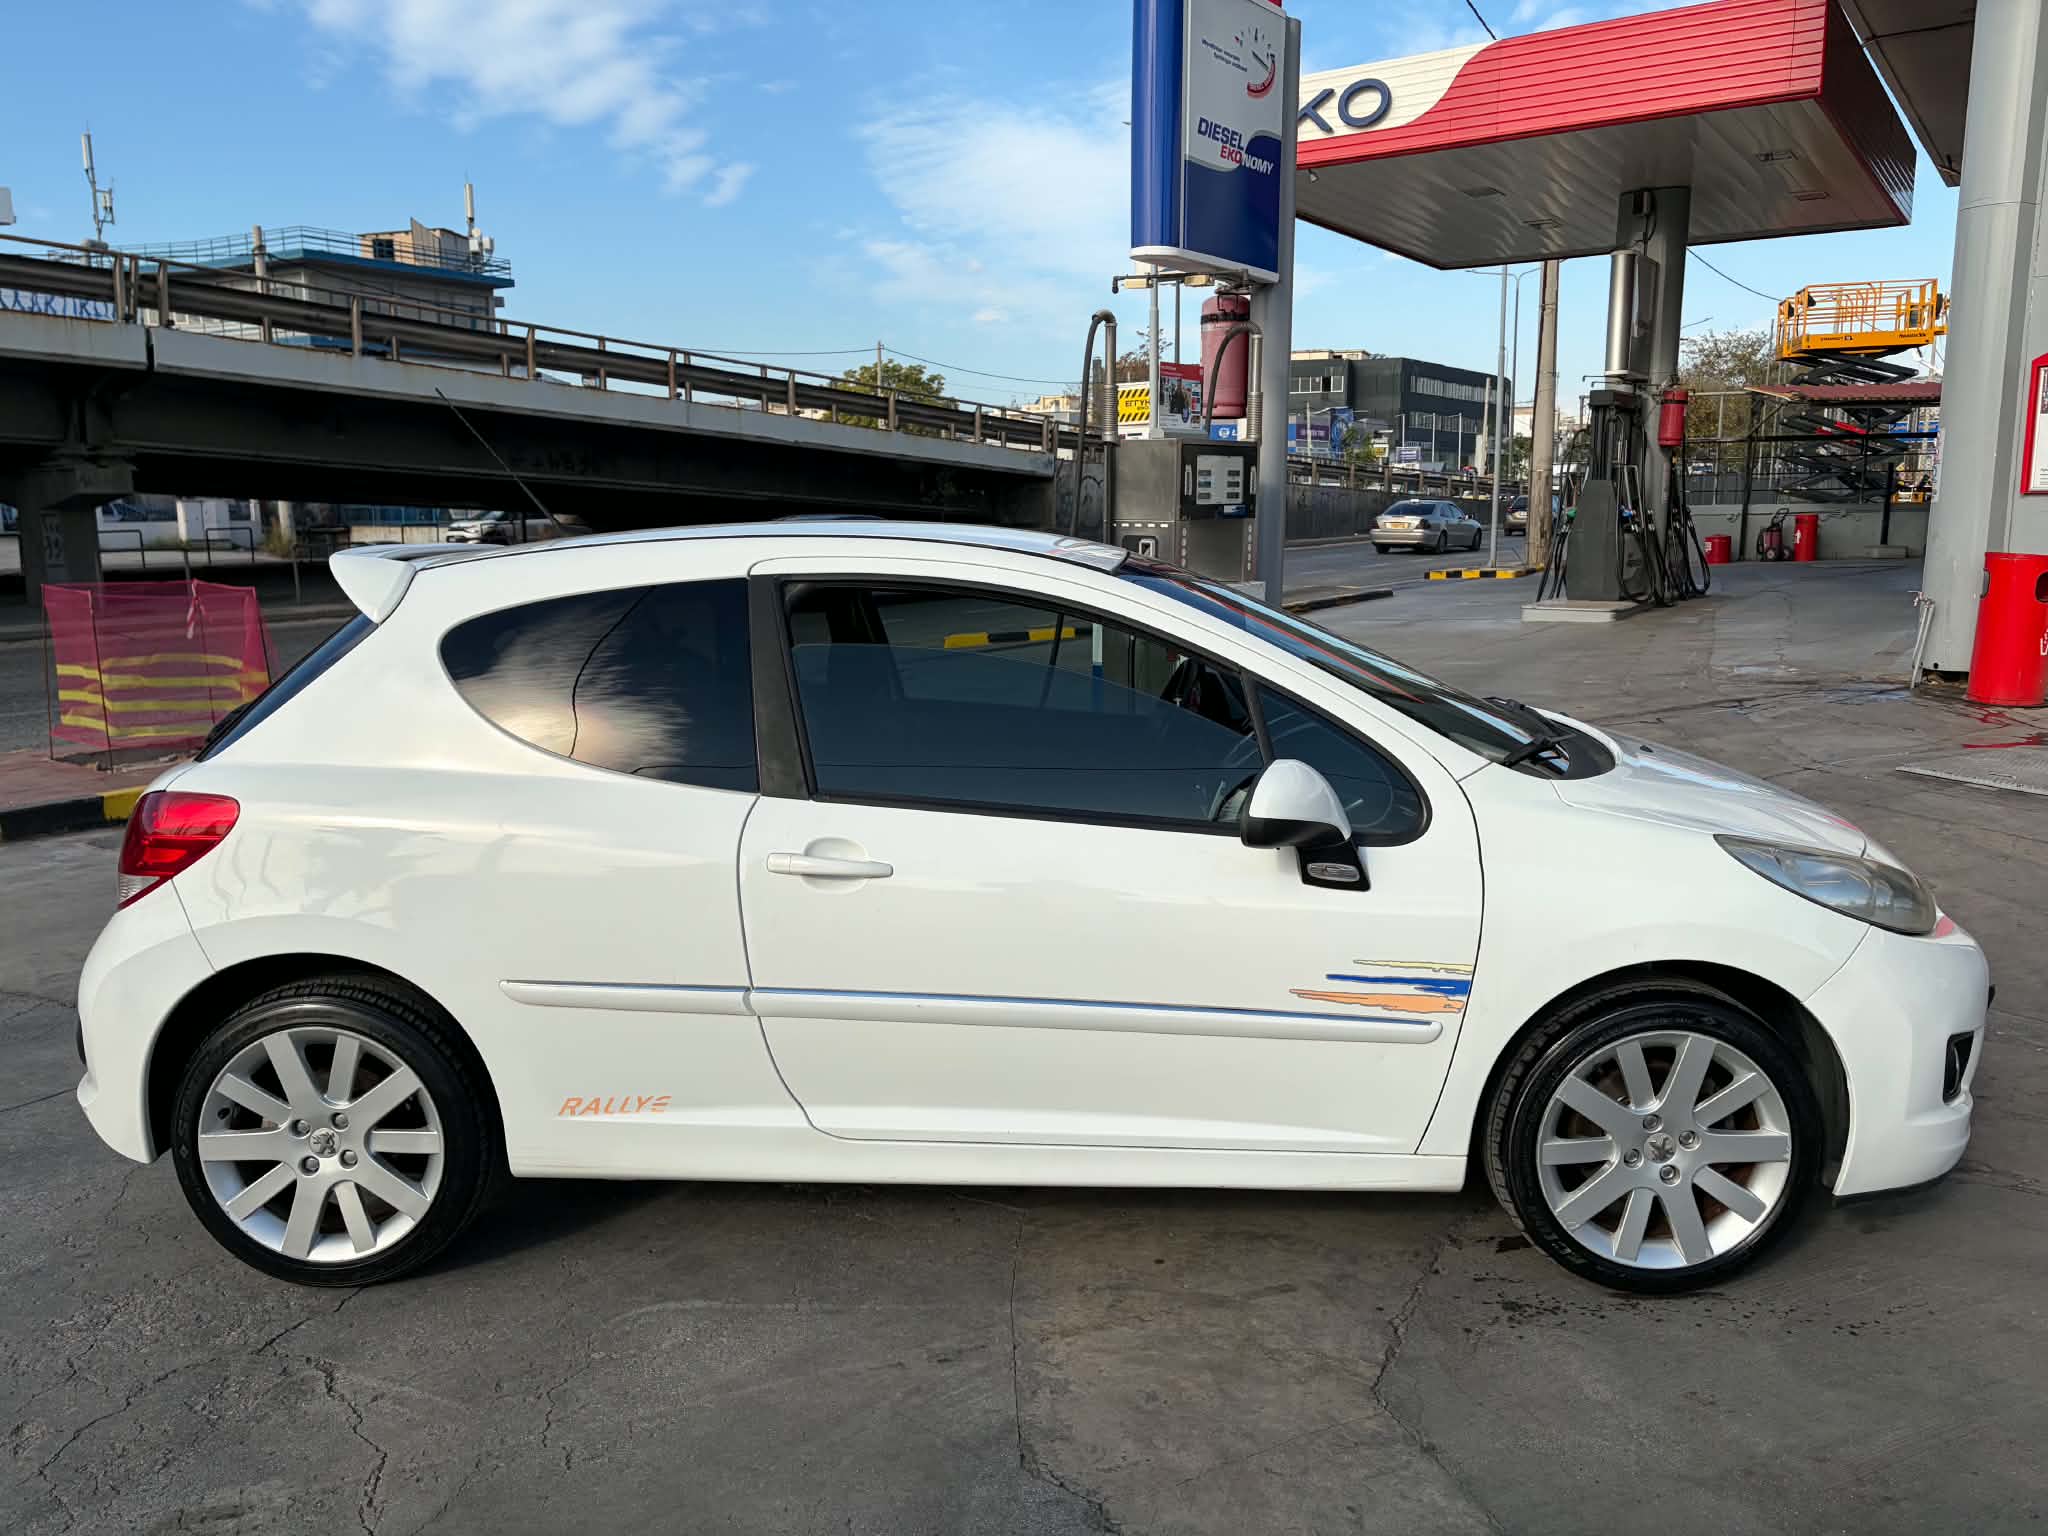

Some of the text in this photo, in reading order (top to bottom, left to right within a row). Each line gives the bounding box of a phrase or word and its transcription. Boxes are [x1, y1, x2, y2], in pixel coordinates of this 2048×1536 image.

[1197, 116, 1244, 151] DIESEL
[1220, 145, 1274, 175] EKONOMY
[558, 1095, 672, 1117] RALLYE
